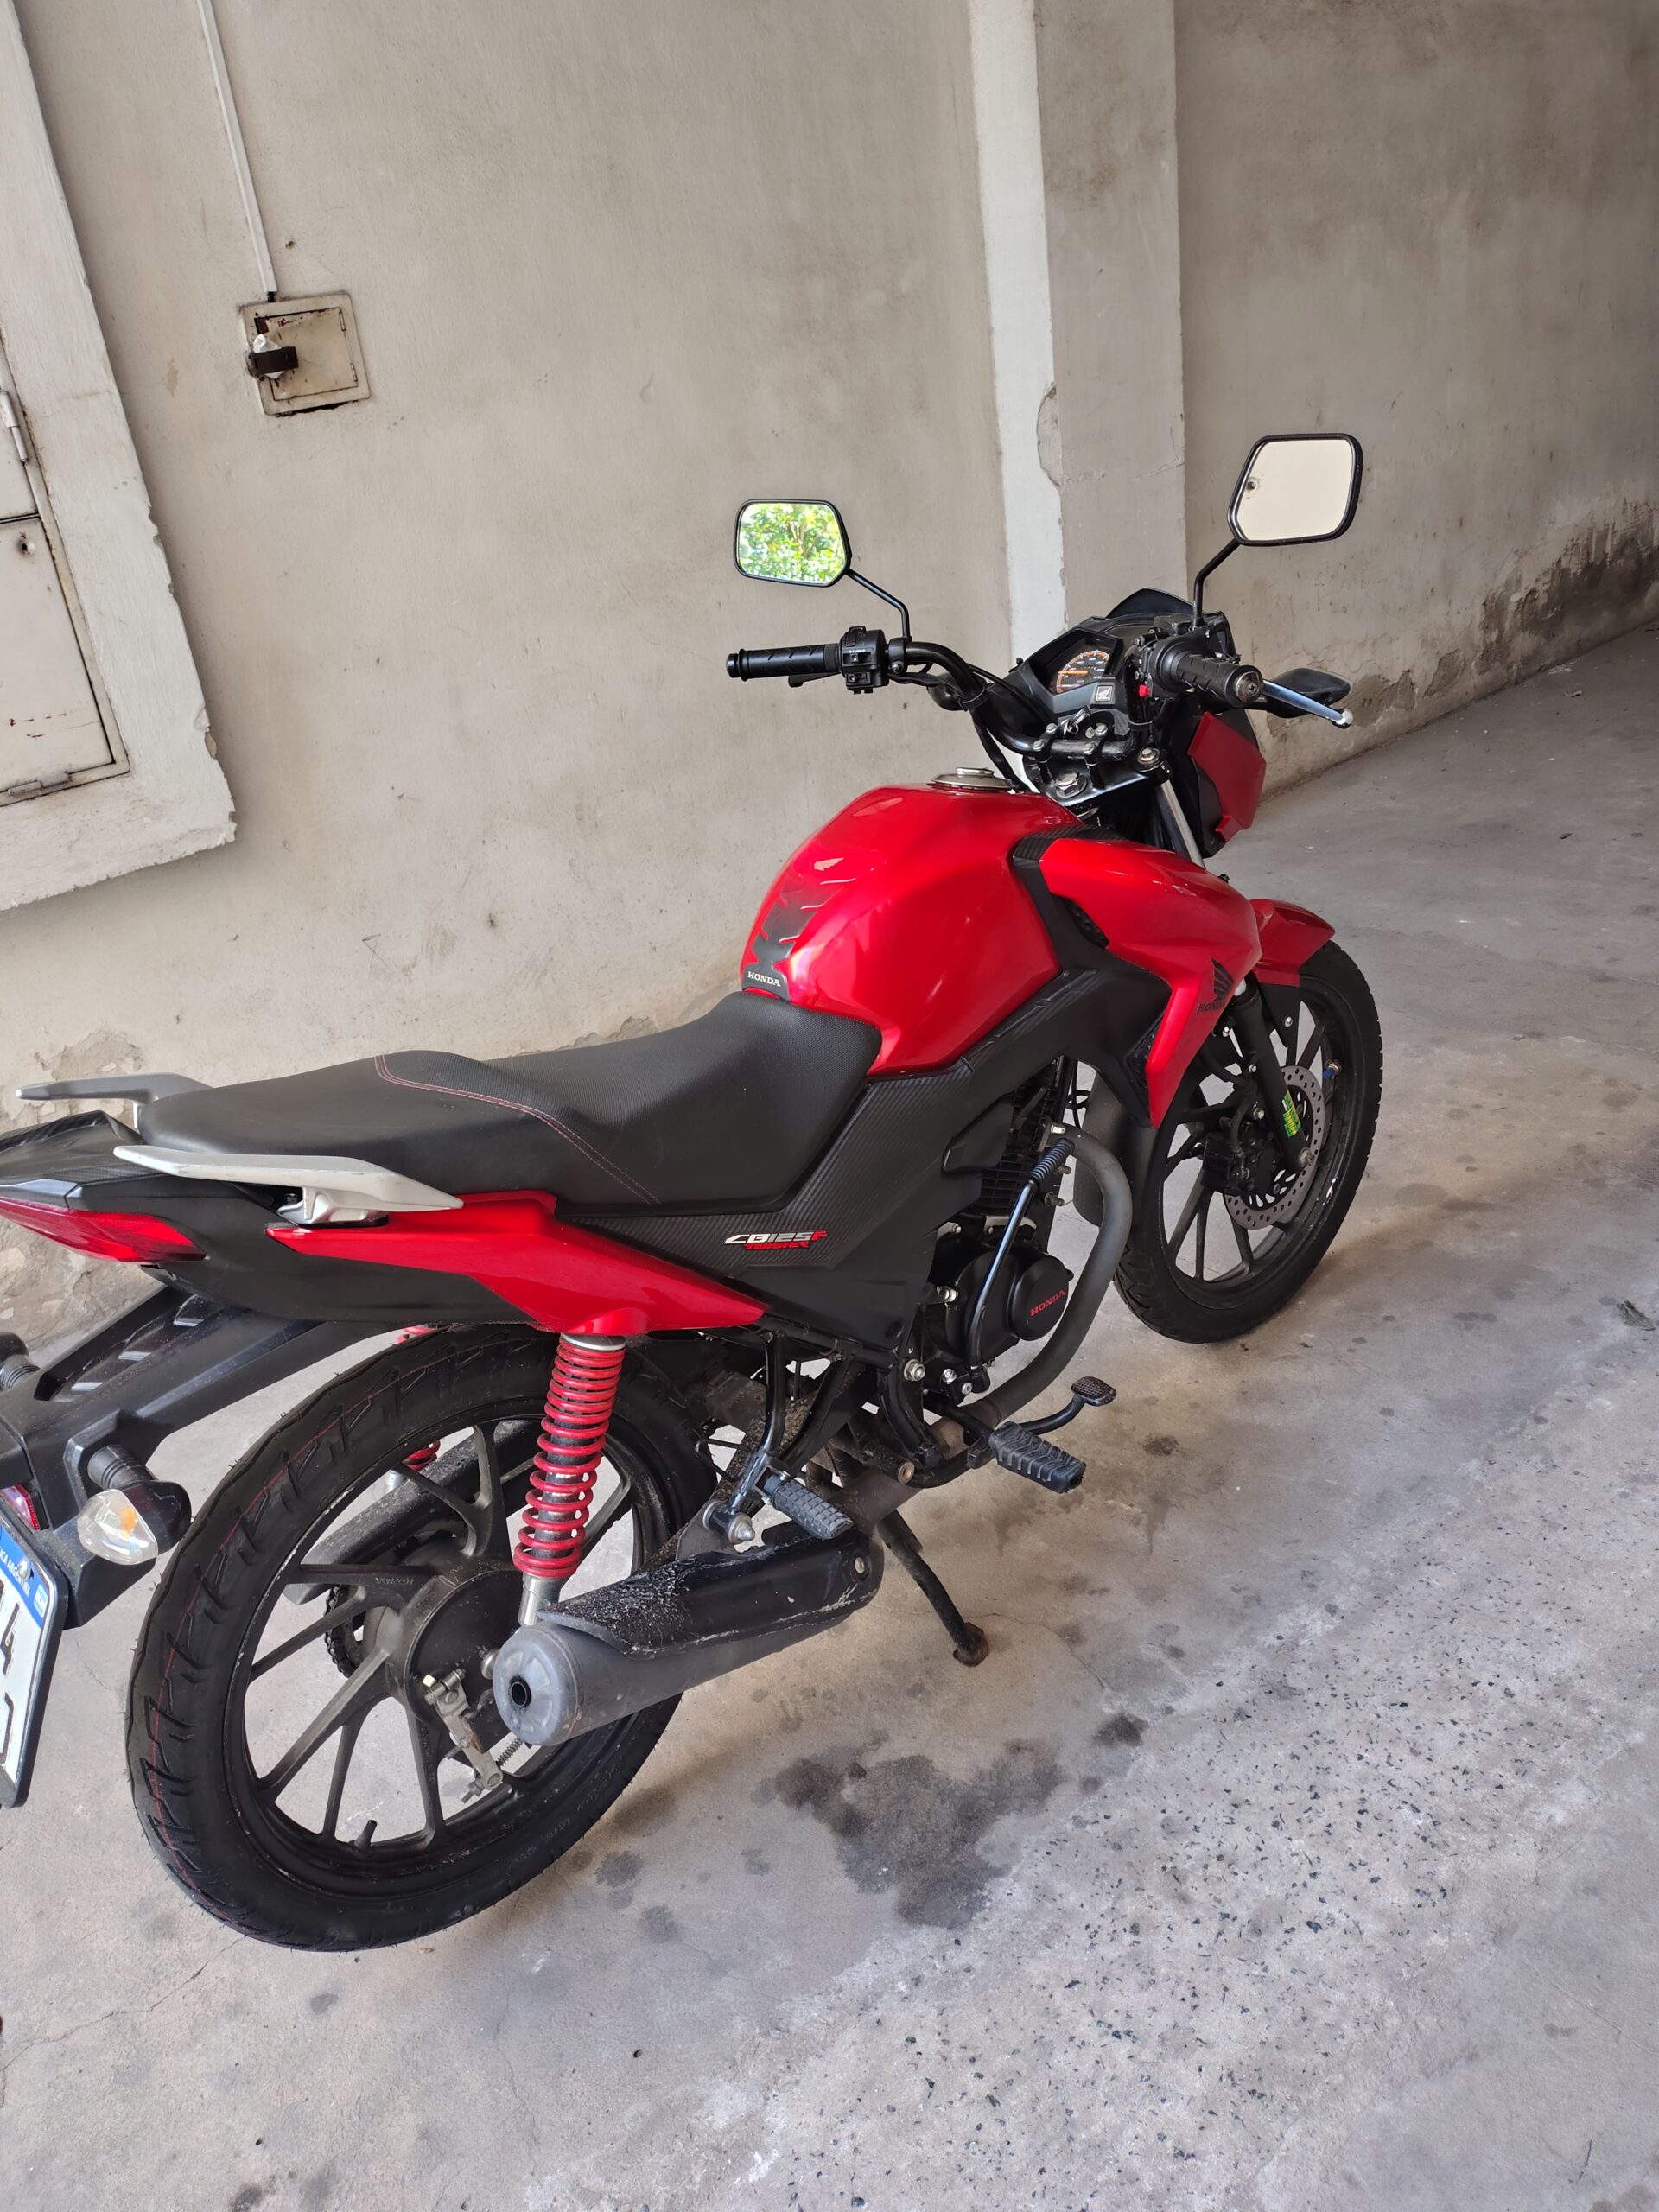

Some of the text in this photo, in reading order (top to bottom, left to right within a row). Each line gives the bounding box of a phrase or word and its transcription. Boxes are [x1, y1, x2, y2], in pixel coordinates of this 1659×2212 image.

[747, 970, 781, 987] HONDA
[724, 1230, 828, 1244] CB125F
[1029, 1289, 1066, 1318] HONDA
